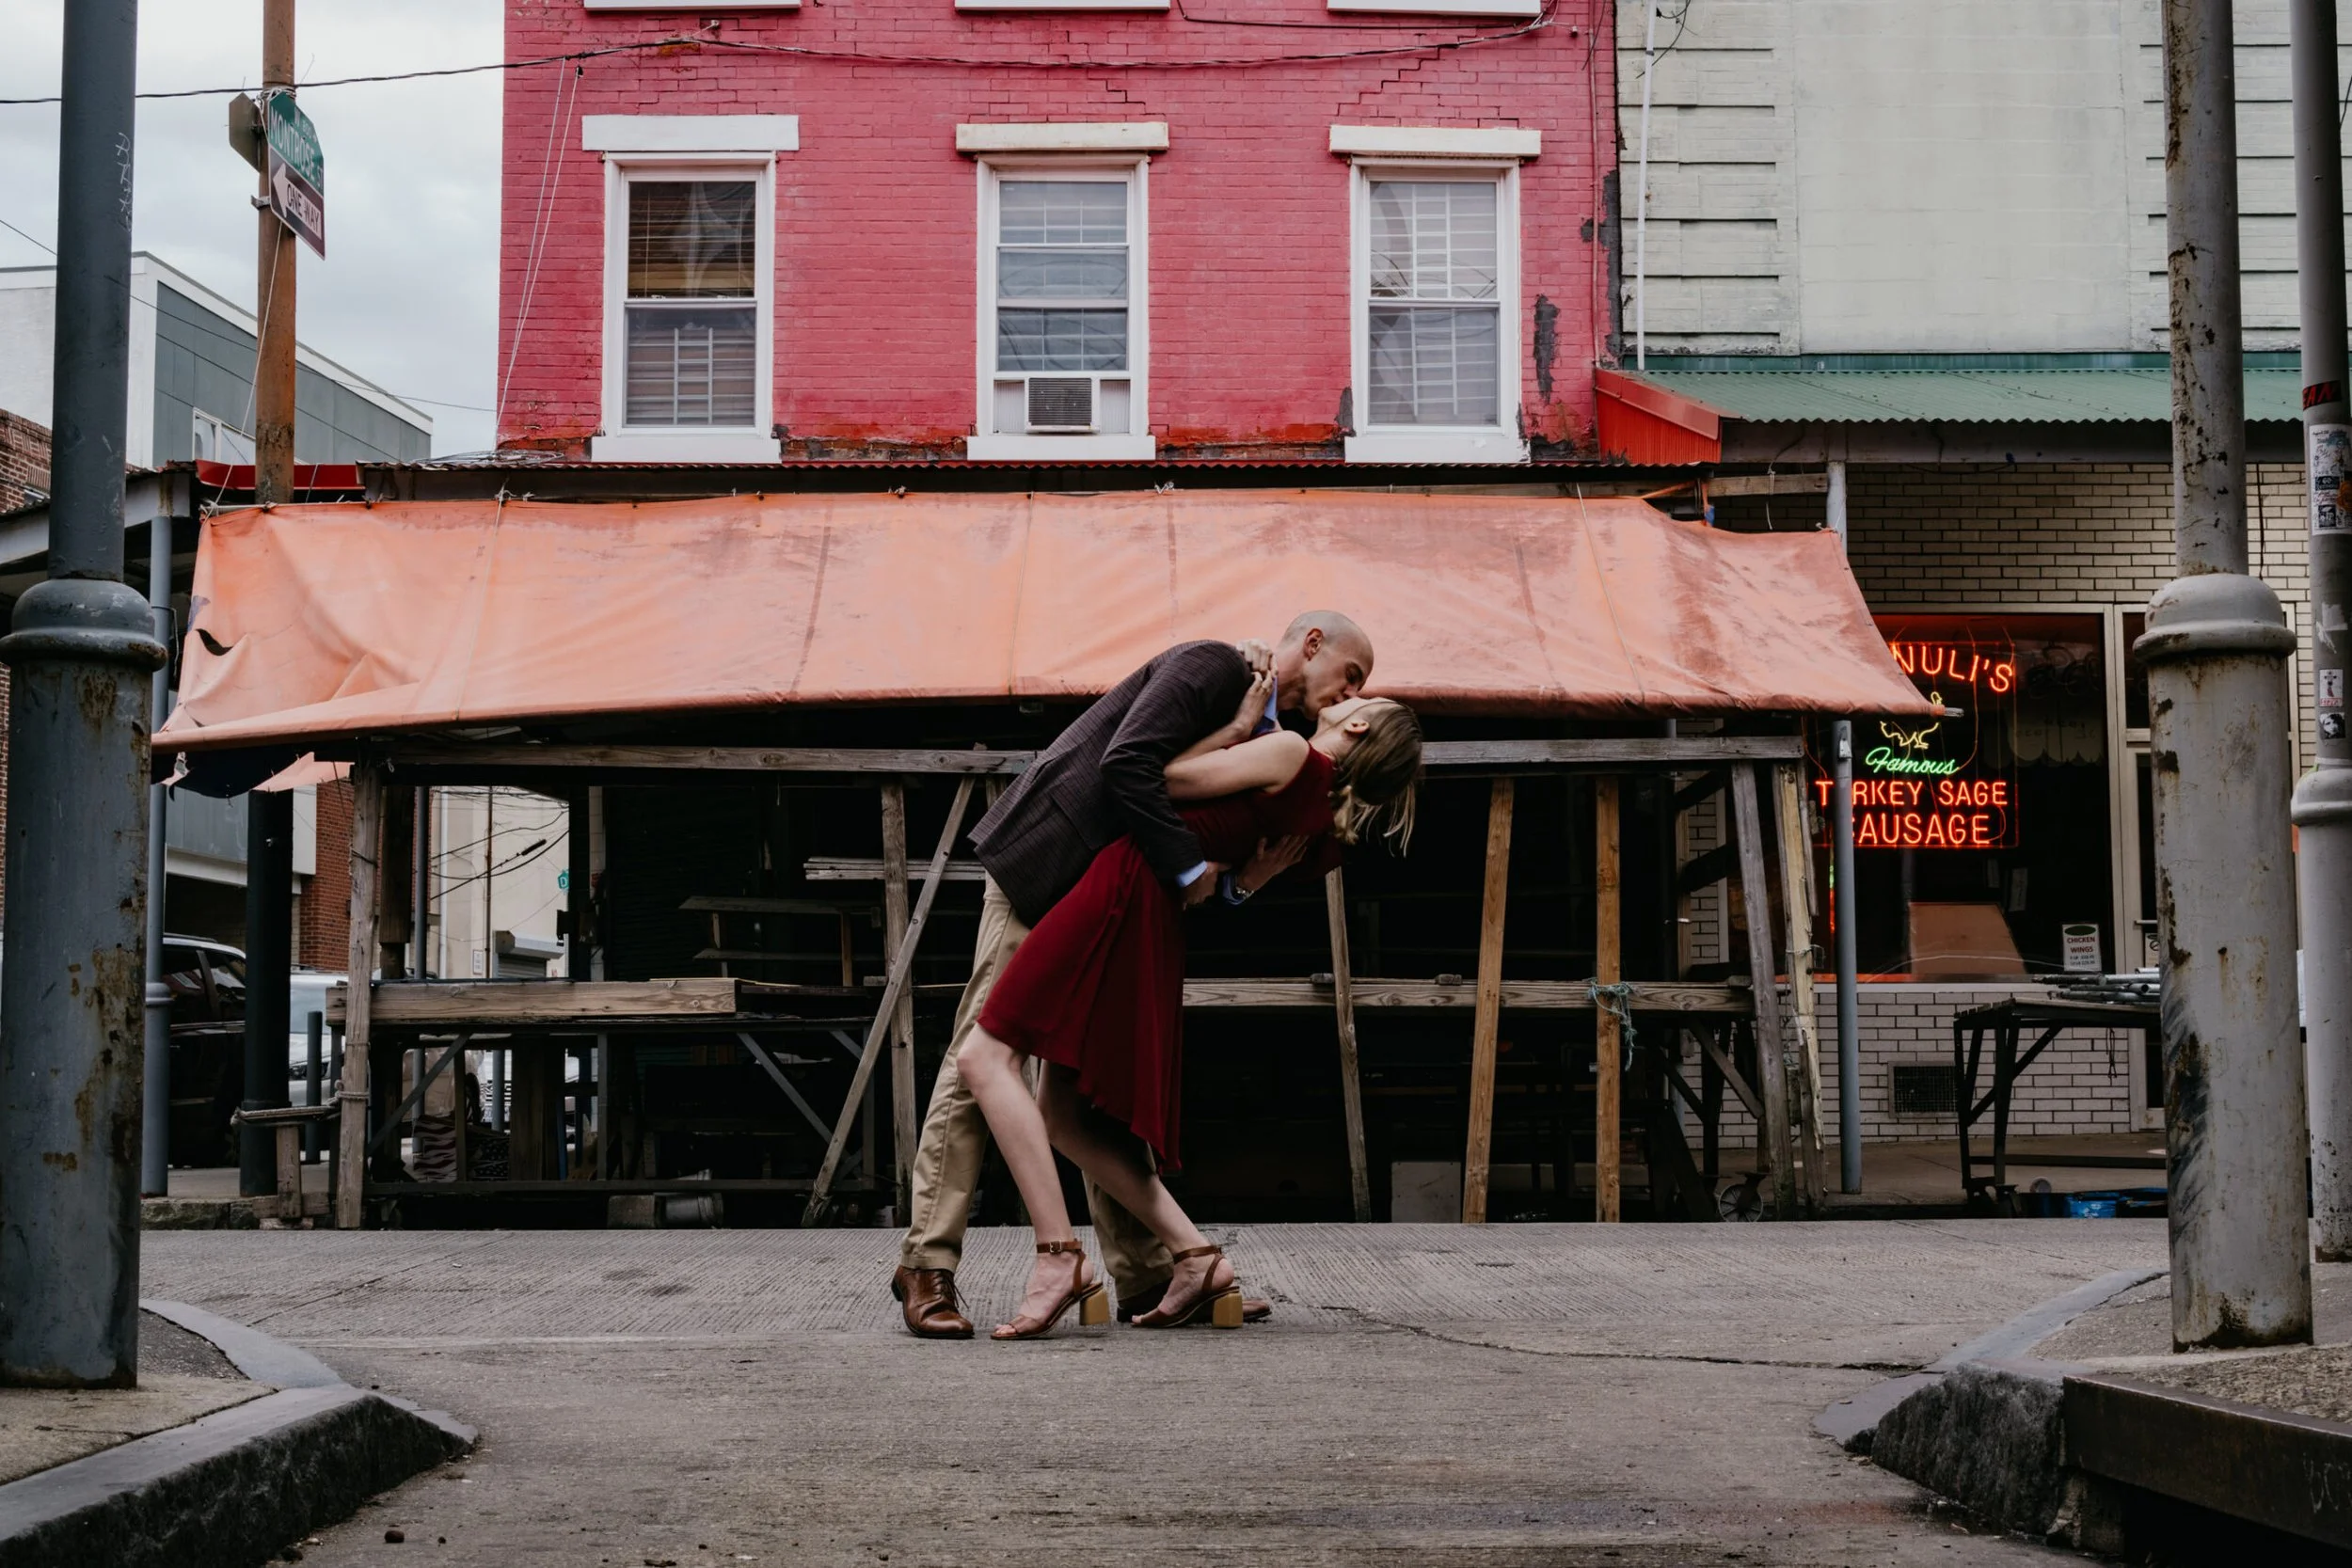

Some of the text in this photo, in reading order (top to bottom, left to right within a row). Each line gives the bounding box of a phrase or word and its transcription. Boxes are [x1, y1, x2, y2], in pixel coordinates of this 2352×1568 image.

[271, 105, 324, 188] MONTROSE ST
[287, 183, 320, 232] ONE WAY
[1865, 747, 1961, 775] Famous
[1816, 781, 2008, 806] TRKEY SAGE
[1851, 814, 1991, 845] AUSAGE
